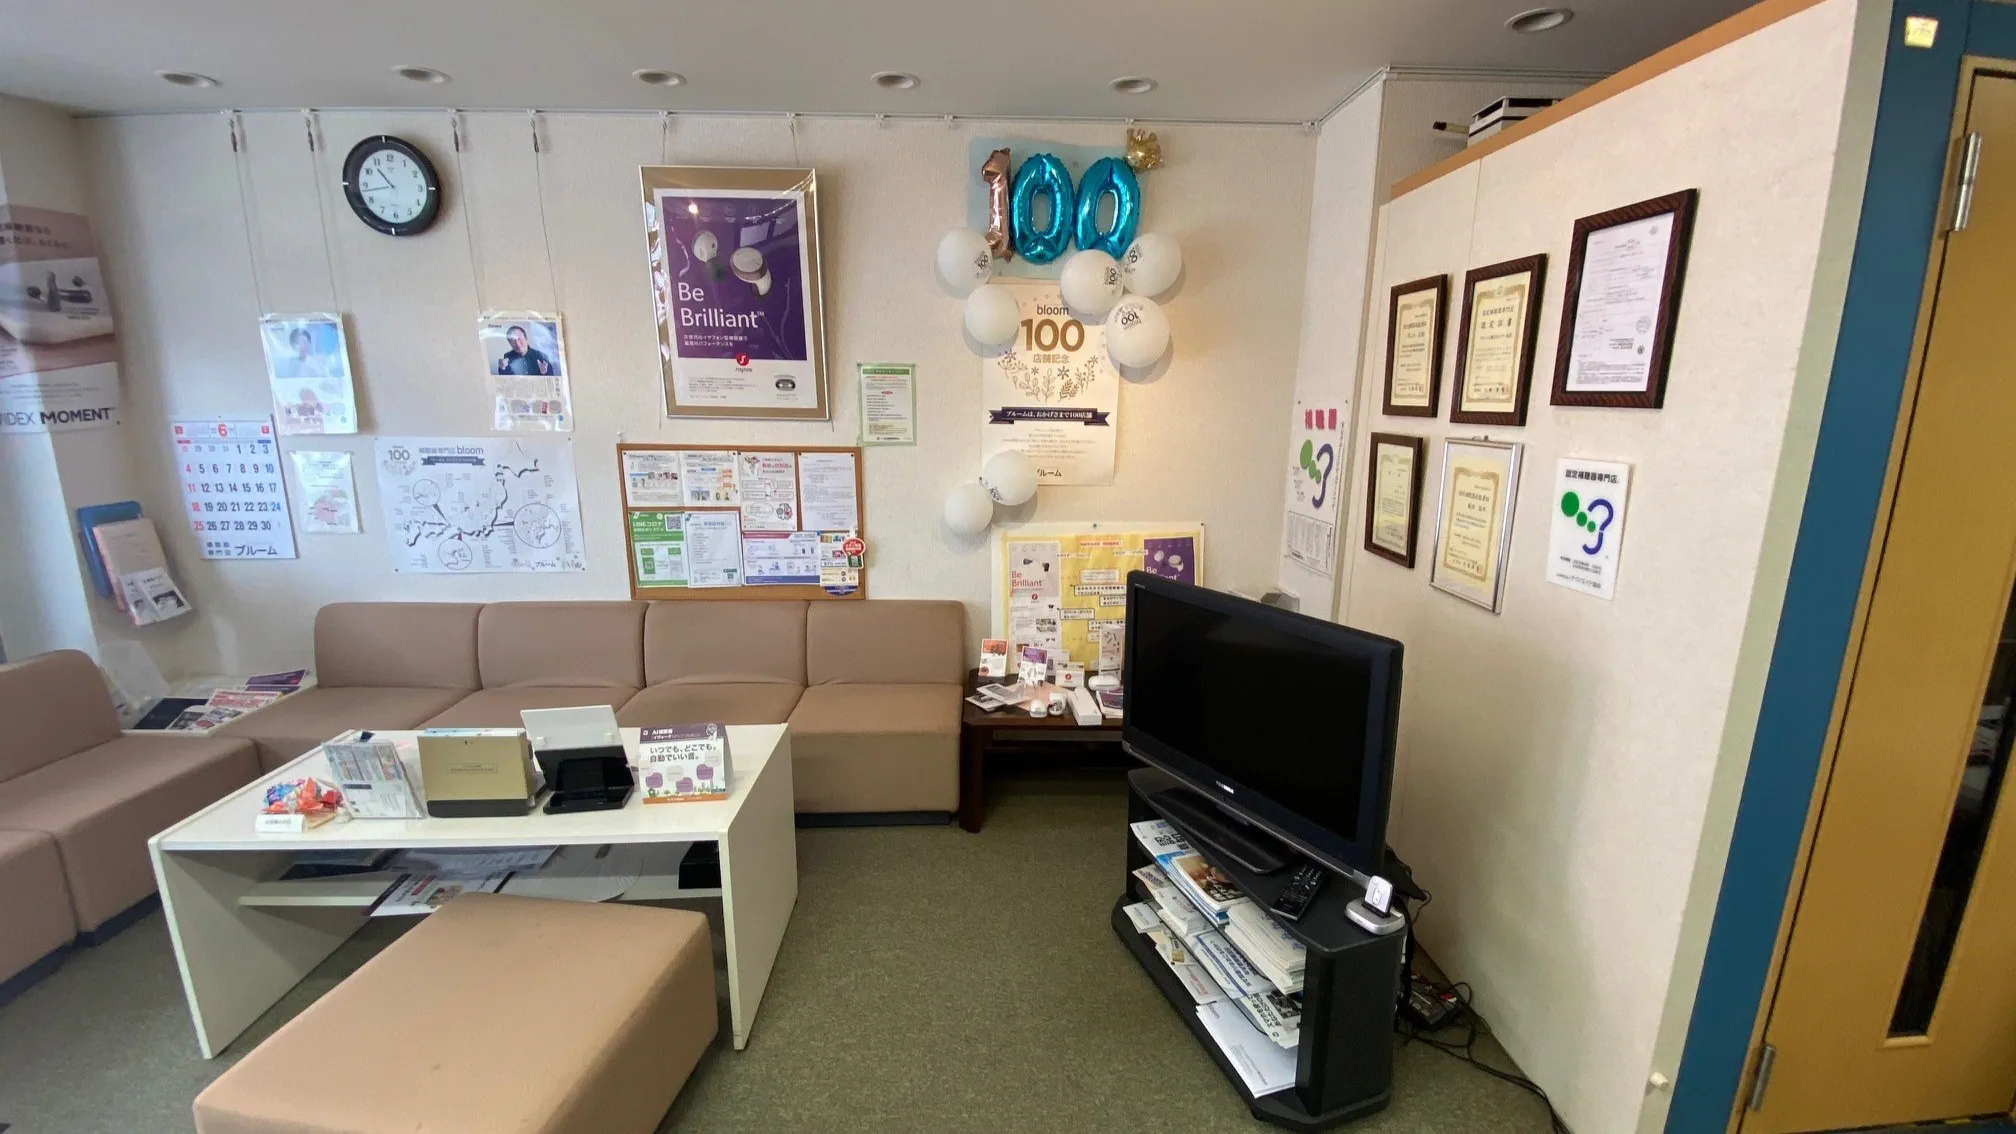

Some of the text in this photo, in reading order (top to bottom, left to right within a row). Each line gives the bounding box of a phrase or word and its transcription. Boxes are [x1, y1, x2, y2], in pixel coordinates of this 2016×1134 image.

[982, 147, 1140, 265] 100
[678, 282, 705, 301] Be
[1037, 304, 1069, 316] bloom
[1020, 318, 1085, 352] 100
[40, 407, 111, 425] MOMENT
[218, 423, 228, 437] 6
[236, 444, 242, 454] 1
[250, 444, 256, 454] 2
[263, 444, 269, 454] 3
[388, 449, 410, 460] 100
[456, 445, 484, 454] bloom
[185, 463, 274, 474] 4 5 6 7 8 9 10
[188, 483, 277, 493] 11 12 13 14 15 16 17
[205, 502, 213, 512] 19
[217, 502, 228, 512] 20
[231, 502, 240, 512] 21
[244, 502, 255, 512] 22
[258, 502, 268, 512] 23
[272, 502, 281, 512] 24
[194, 521, 203, 531] 25
[207, 521, 217, 531] 26
[221, 521, 230, 531] 27
[235, 521, 245, 531] 28
[248, 521, 258, 531] 29
[261, 521, 271, 531] 30
[234, 545, 278, 556] ブルーム
[1012, 579, 1042, 587] Brilliant
[650, 743, 716, 754] いつでも、どこでも。
[650, 753, 699, 763] 自動でいい音。
